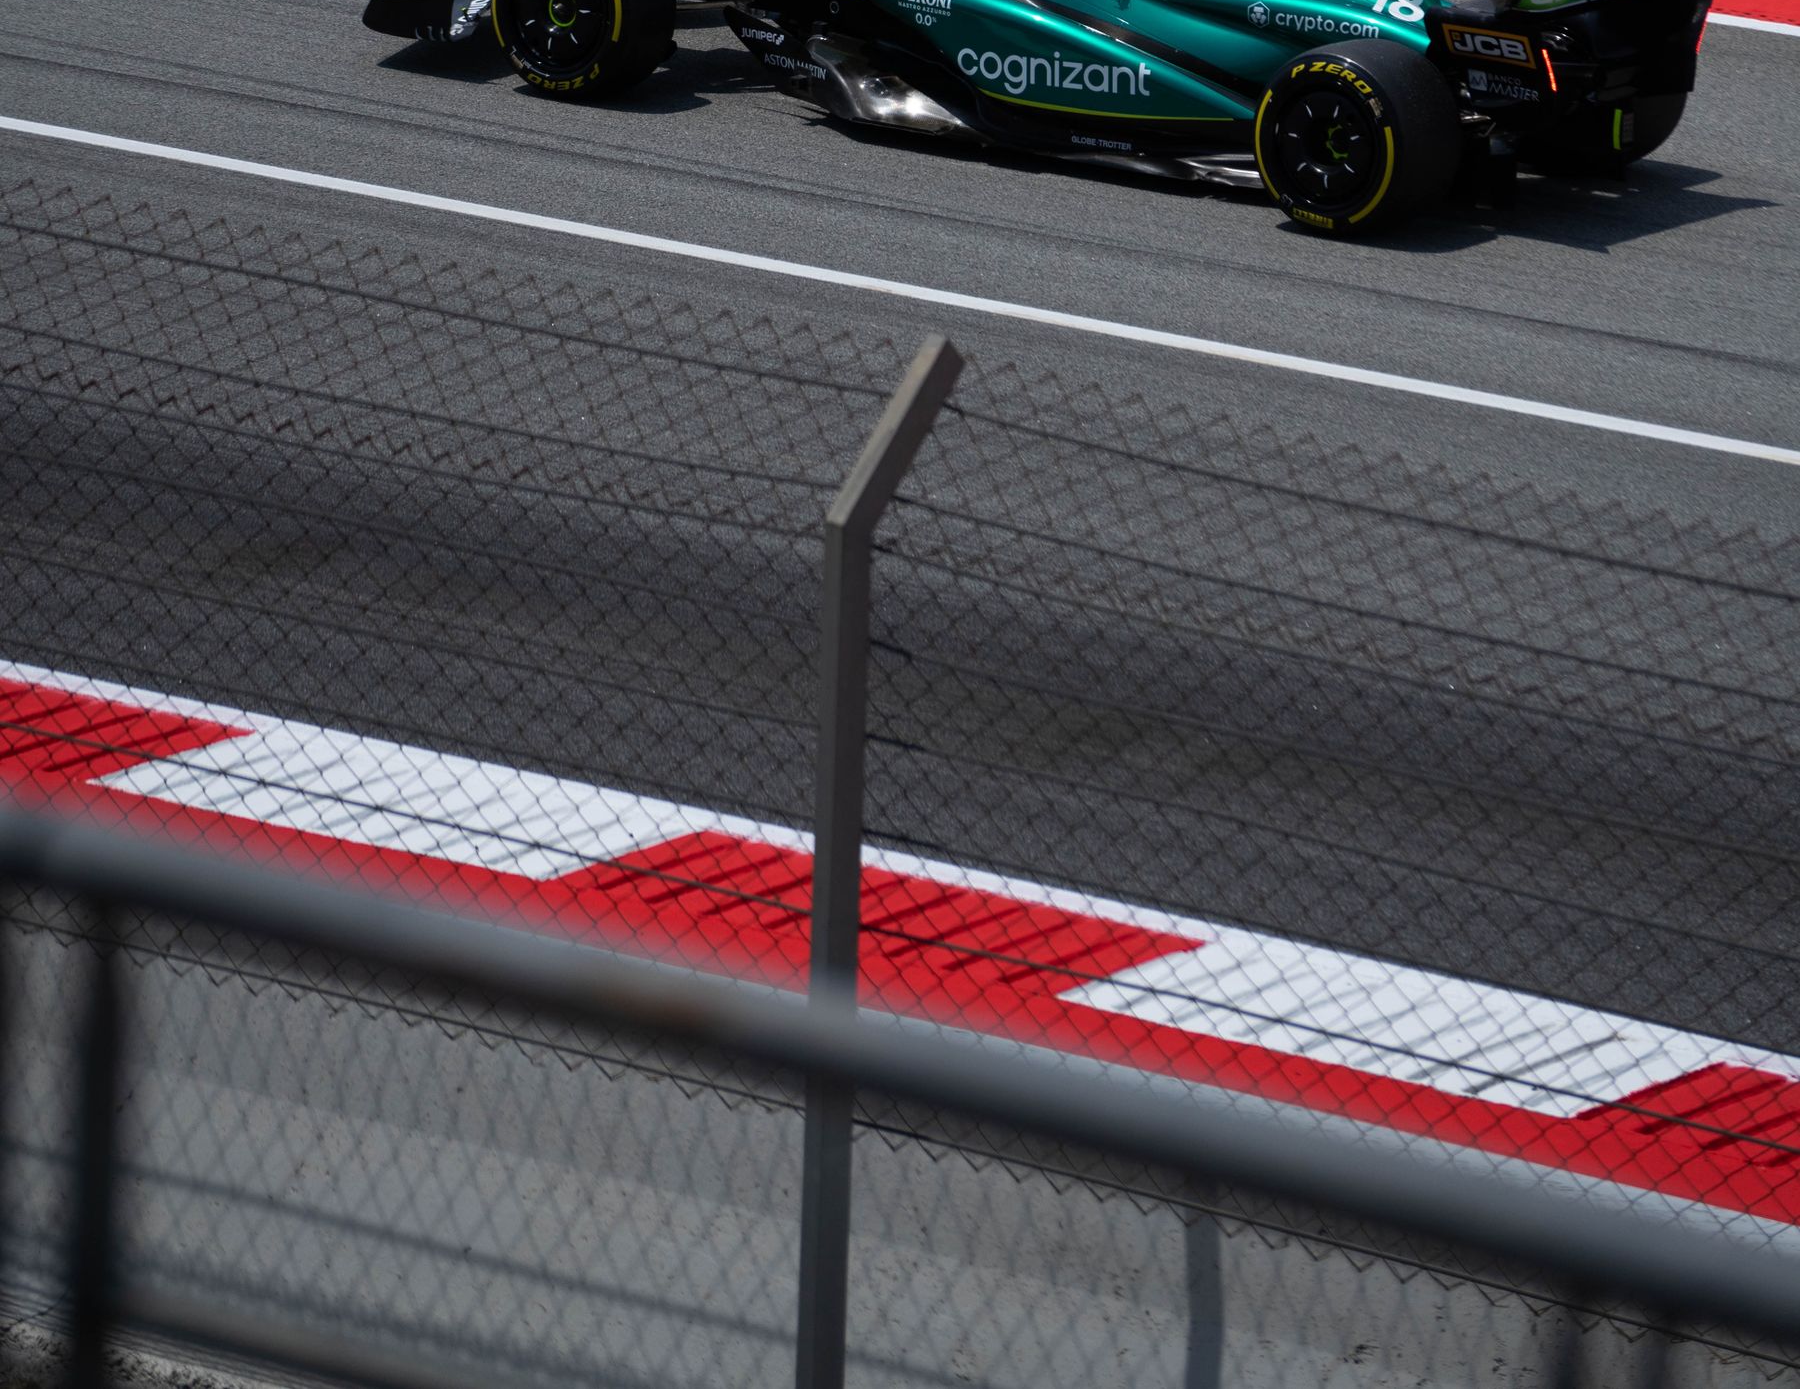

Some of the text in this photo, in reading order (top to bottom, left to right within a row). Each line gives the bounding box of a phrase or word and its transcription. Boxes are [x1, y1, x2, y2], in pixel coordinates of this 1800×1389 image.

[922, 6, 952, 17] AZZURRO
[1275, 11, 1380, 39] crypto.com
[1453, 33, 1528, 62] JCB
[764, 52, 795, 71] ASTON
[957, 48, 1151, 96] cognizant
[527, 72, 585, 91] ZERO
[1290, 61, 1373, 95] P ZERO
[1489, 83, 1540, 102] MASTER
